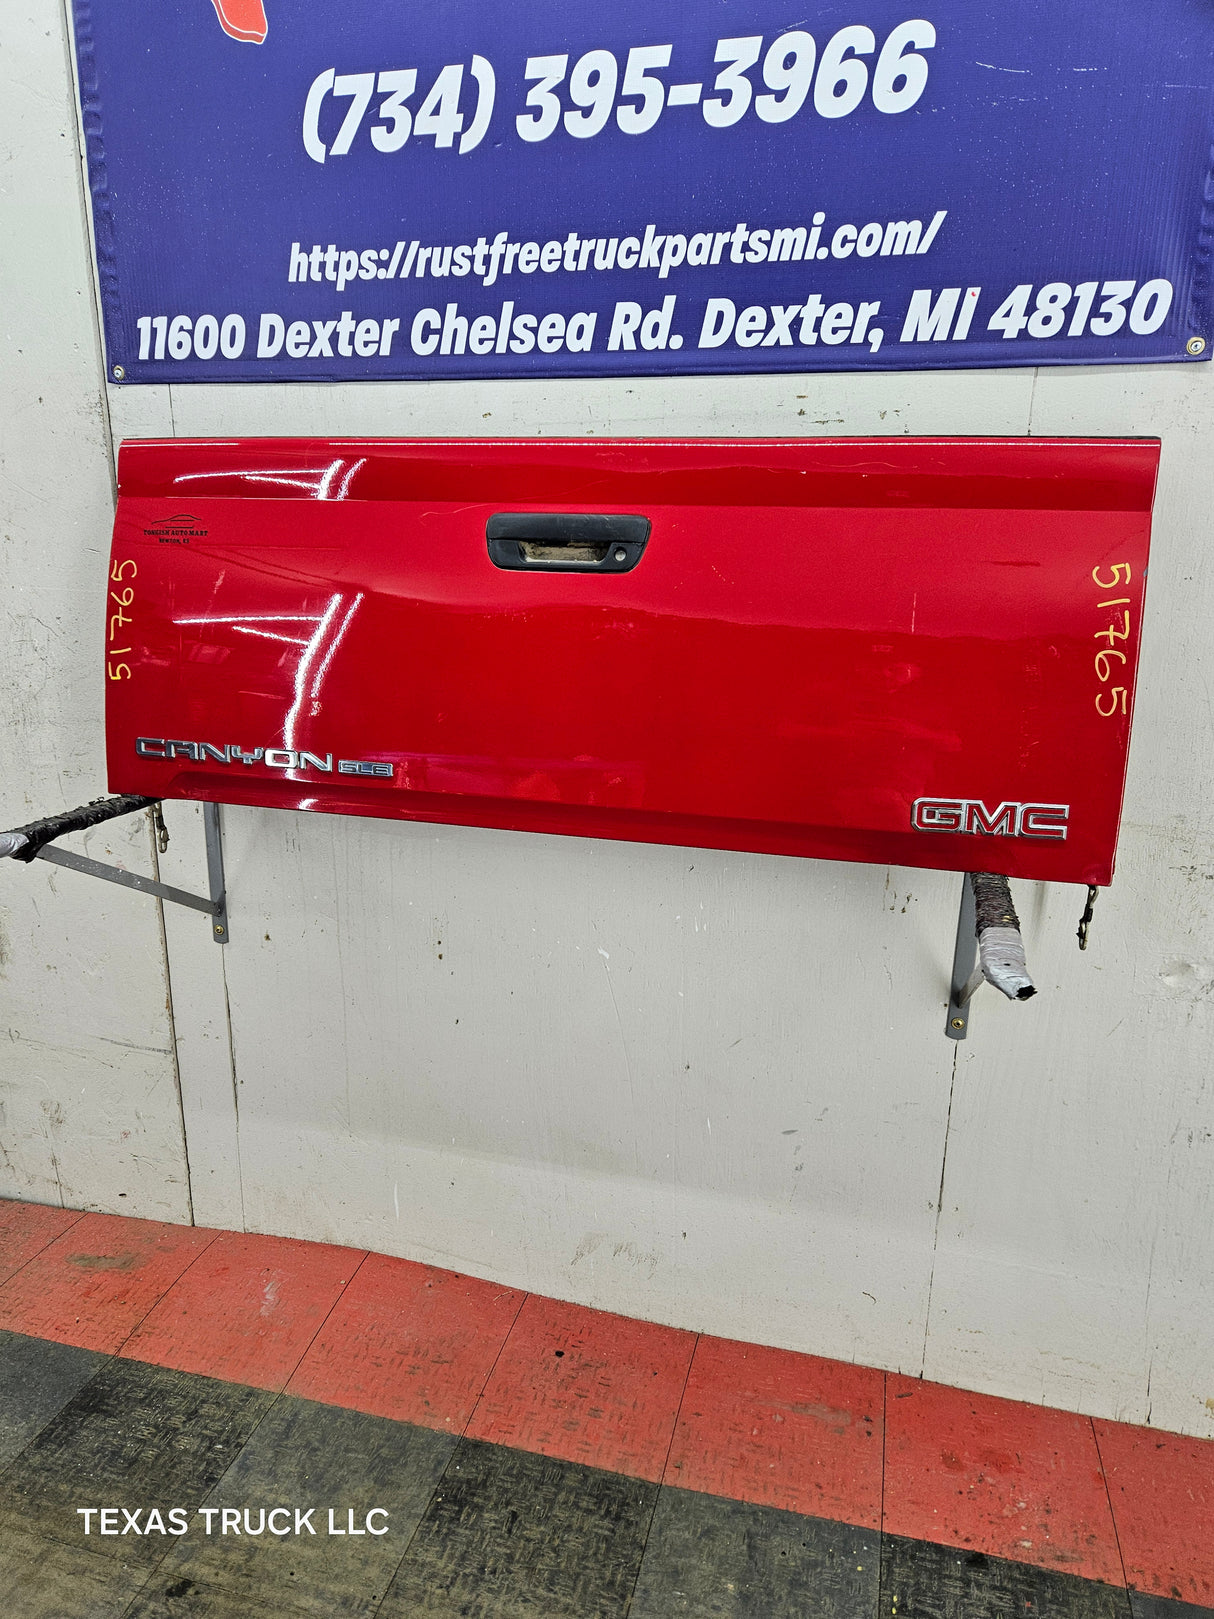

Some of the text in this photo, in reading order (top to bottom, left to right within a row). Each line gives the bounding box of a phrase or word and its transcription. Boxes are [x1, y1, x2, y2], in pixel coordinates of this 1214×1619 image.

[303, 19, 937, 164] (734) 395-3966
[288, 211, 947, 291] https://rustfreetruckpartsmi.com/
[136, 278, 1174, 361] 11600 Dexter Chelsea Rd. Dexter, MI 48130
[109, 559, 138, 681] 51765
[1092, 562, 1132, 718] 51765
[136, 736, 333, 772] CANYON
[910, 797, 1070, 841] GMC
